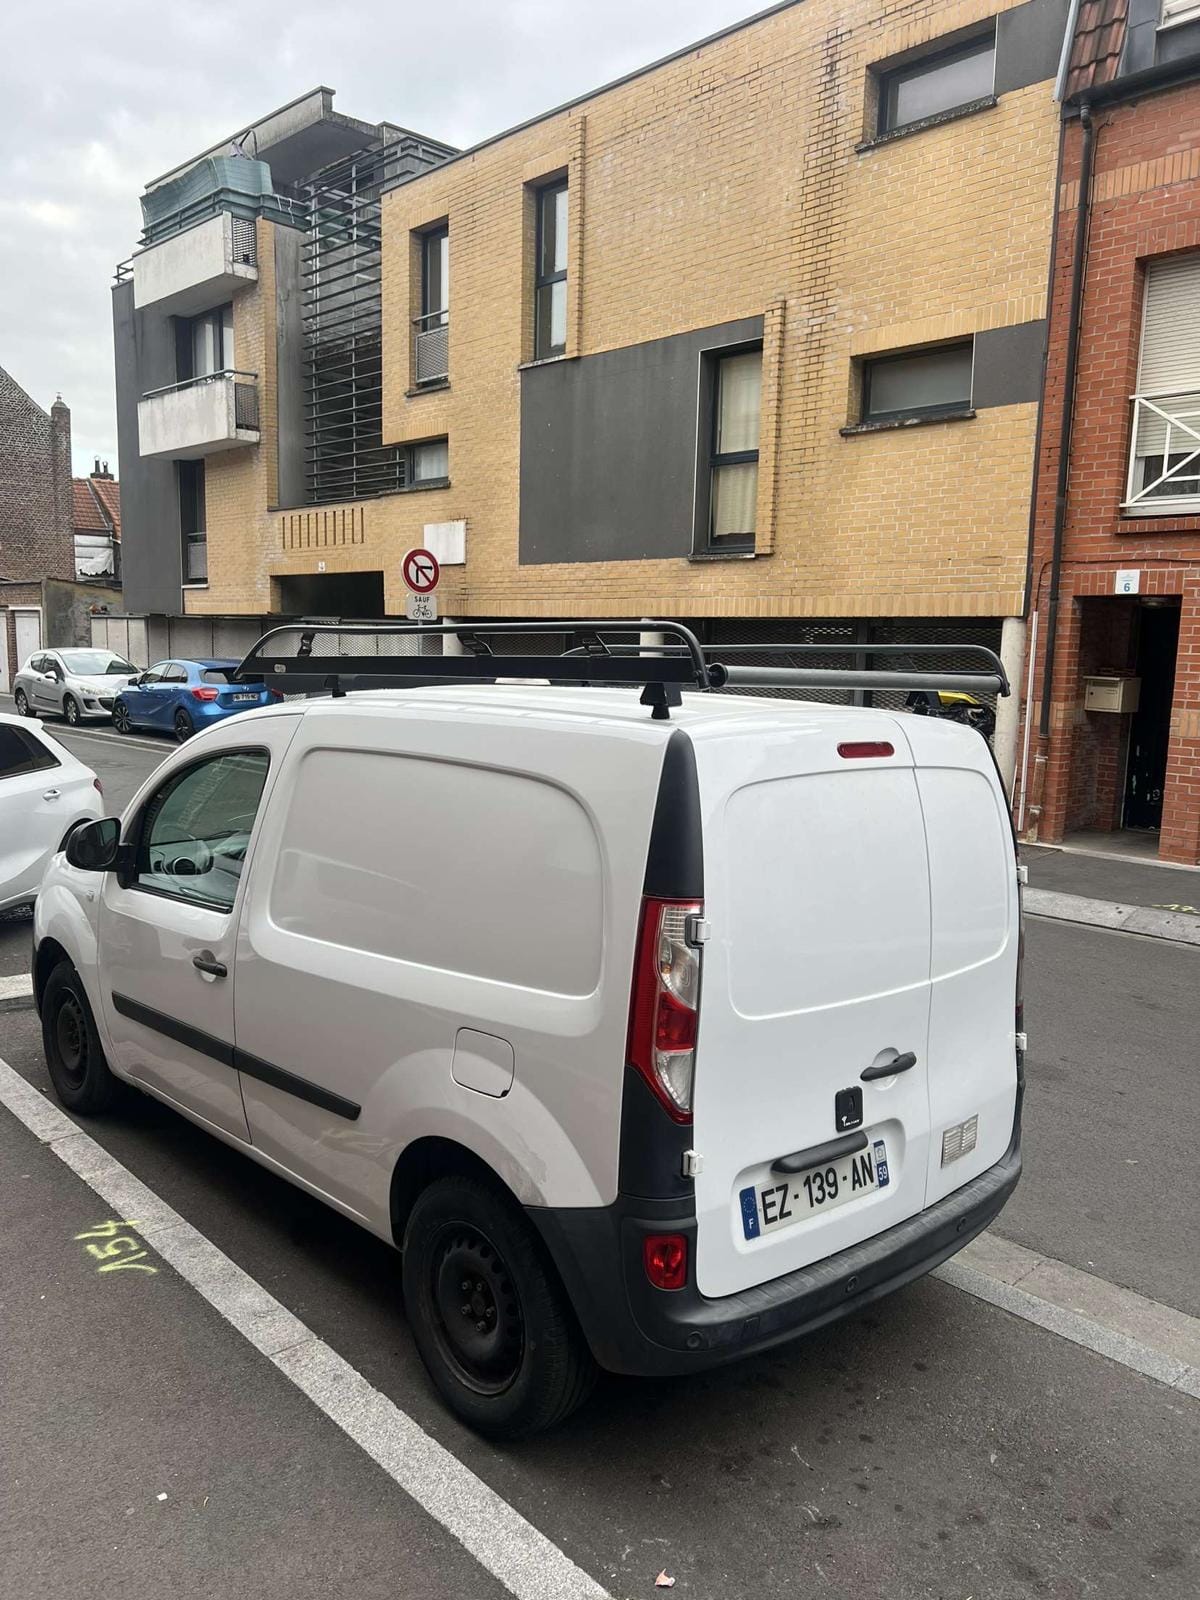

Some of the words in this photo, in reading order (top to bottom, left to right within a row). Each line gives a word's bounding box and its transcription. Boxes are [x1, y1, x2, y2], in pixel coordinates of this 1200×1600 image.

[1123, 582, 1131, 592] 6
[414, 595, 430, 603] SAUF
[748, 1218, 755, 1230] F
[877, 1165, 888, 1181] 59
